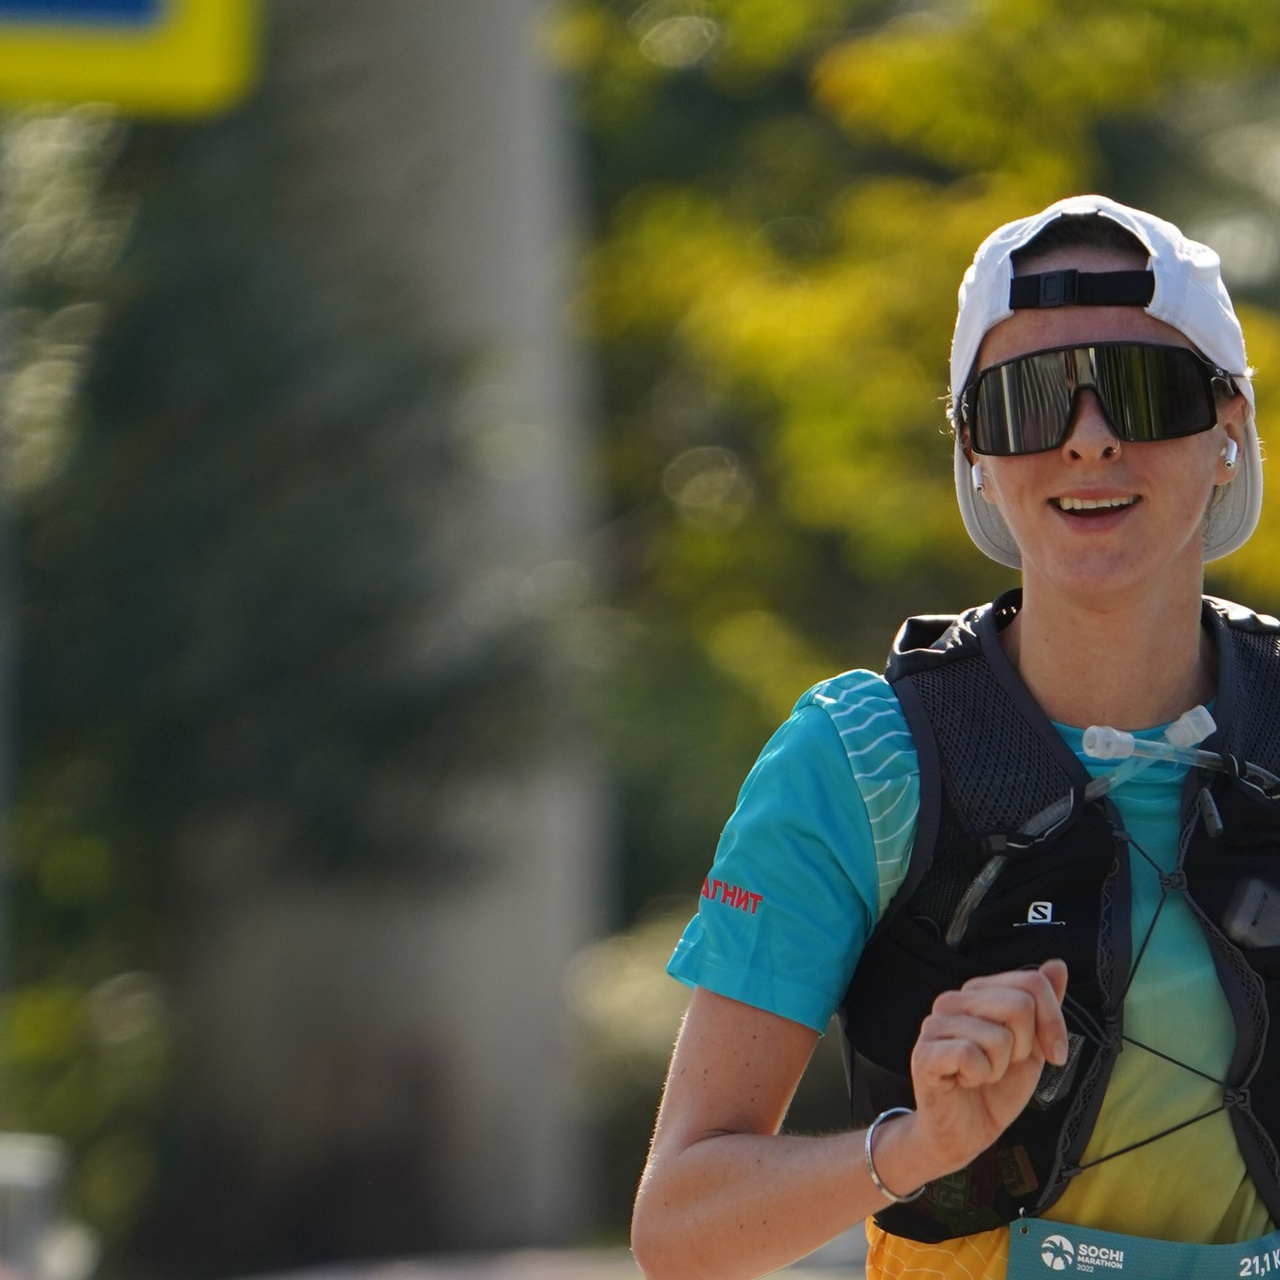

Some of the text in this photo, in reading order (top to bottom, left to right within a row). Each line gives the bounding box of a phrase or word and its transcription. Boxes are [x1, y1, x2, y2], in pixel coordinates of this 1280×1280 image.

[1077, 1243, 1125, 1262] SOCHI
[1076, 1264, 1095, 1274] 2022
[1077, 1255, 1124, 1270] MARATHON
[1239, 1253, 1271, 1277] 21,1
